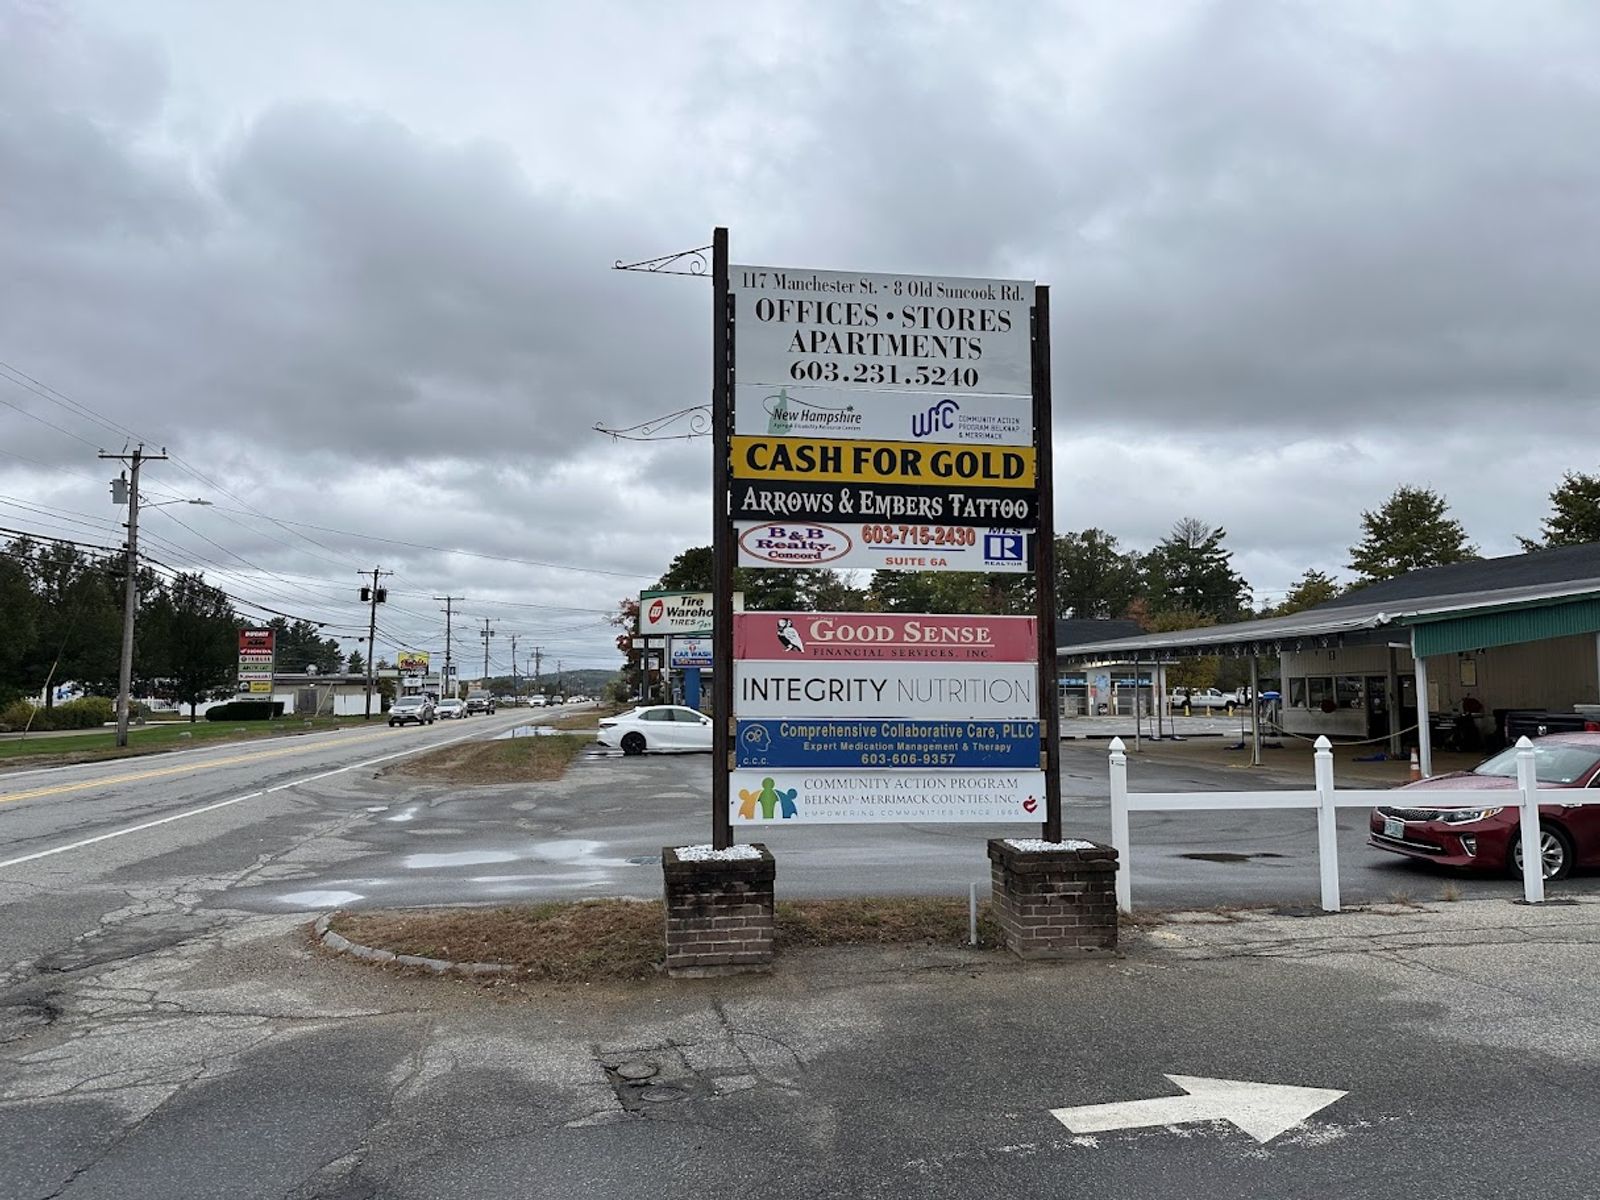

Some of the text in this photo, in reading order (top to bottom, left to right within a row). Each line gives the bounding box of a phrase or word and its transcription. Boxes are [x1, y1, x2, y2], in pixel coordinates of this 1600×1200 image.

[742, 272, 767, 289] 117
[773, 273, 855, 294] Manchester
[859, 277, 878, 295] St.
[893, 280, 902, 296] 8
[908, 280, 933, 298] Old
[936, 282, 996, 300] Suncook
[1001, 284, 1024, 301] Rd.
[755, 297, 1012, 333] OFFICES STORES
[787, 329, 983, 360] APARTMENTS
[790, 359, 979, 388] 603.231.5240
[773, 408, 862, 425] New Hampshire
[958, 415, 995, 424] COMMUNITY
[958, 423, 989, 431] PROGRAM
[746, 443, 1025, 479] CASH FOR GOLD
[740, 486, 1029, 520] ARROWS & EMBERS TATTOO
[861, 524, 976, 547] 603-715-2430
[988, 527, 1021, 535] MLS
[755, 539, 830, 552] Realty
[768, 551, 821, 560] Concord
[885, 557, 947, 567] SUITE 6A
[681, 596, 704, 606] Tire
[667, 607, 713, 617] Wareho
[810, 620, 991, 643] GOOD SENSE
[813, 647, 884, 657] FINANCIAL
[966, 649, 993, 658] INC.
[743, 677, 1031, 704] INTEGRITY NUTRITION
[780, 722, 1034, 740] Comprehensive Collaborative Care, PLLC
[803, 742, 837, 752] Expert
[840, 742, 894, 750] Medication
[897, 742, 958, 752] Management
[973, 742, 1012, 753] Therapy
[861, 753, 956, 764] 603-606-9357
[804, 778, 1018, 790] COMMUNITY ACTION PROGRAM
[994, 794, 1019, 804] INC.
[805, 809, 874, 817] EMPOWERING
